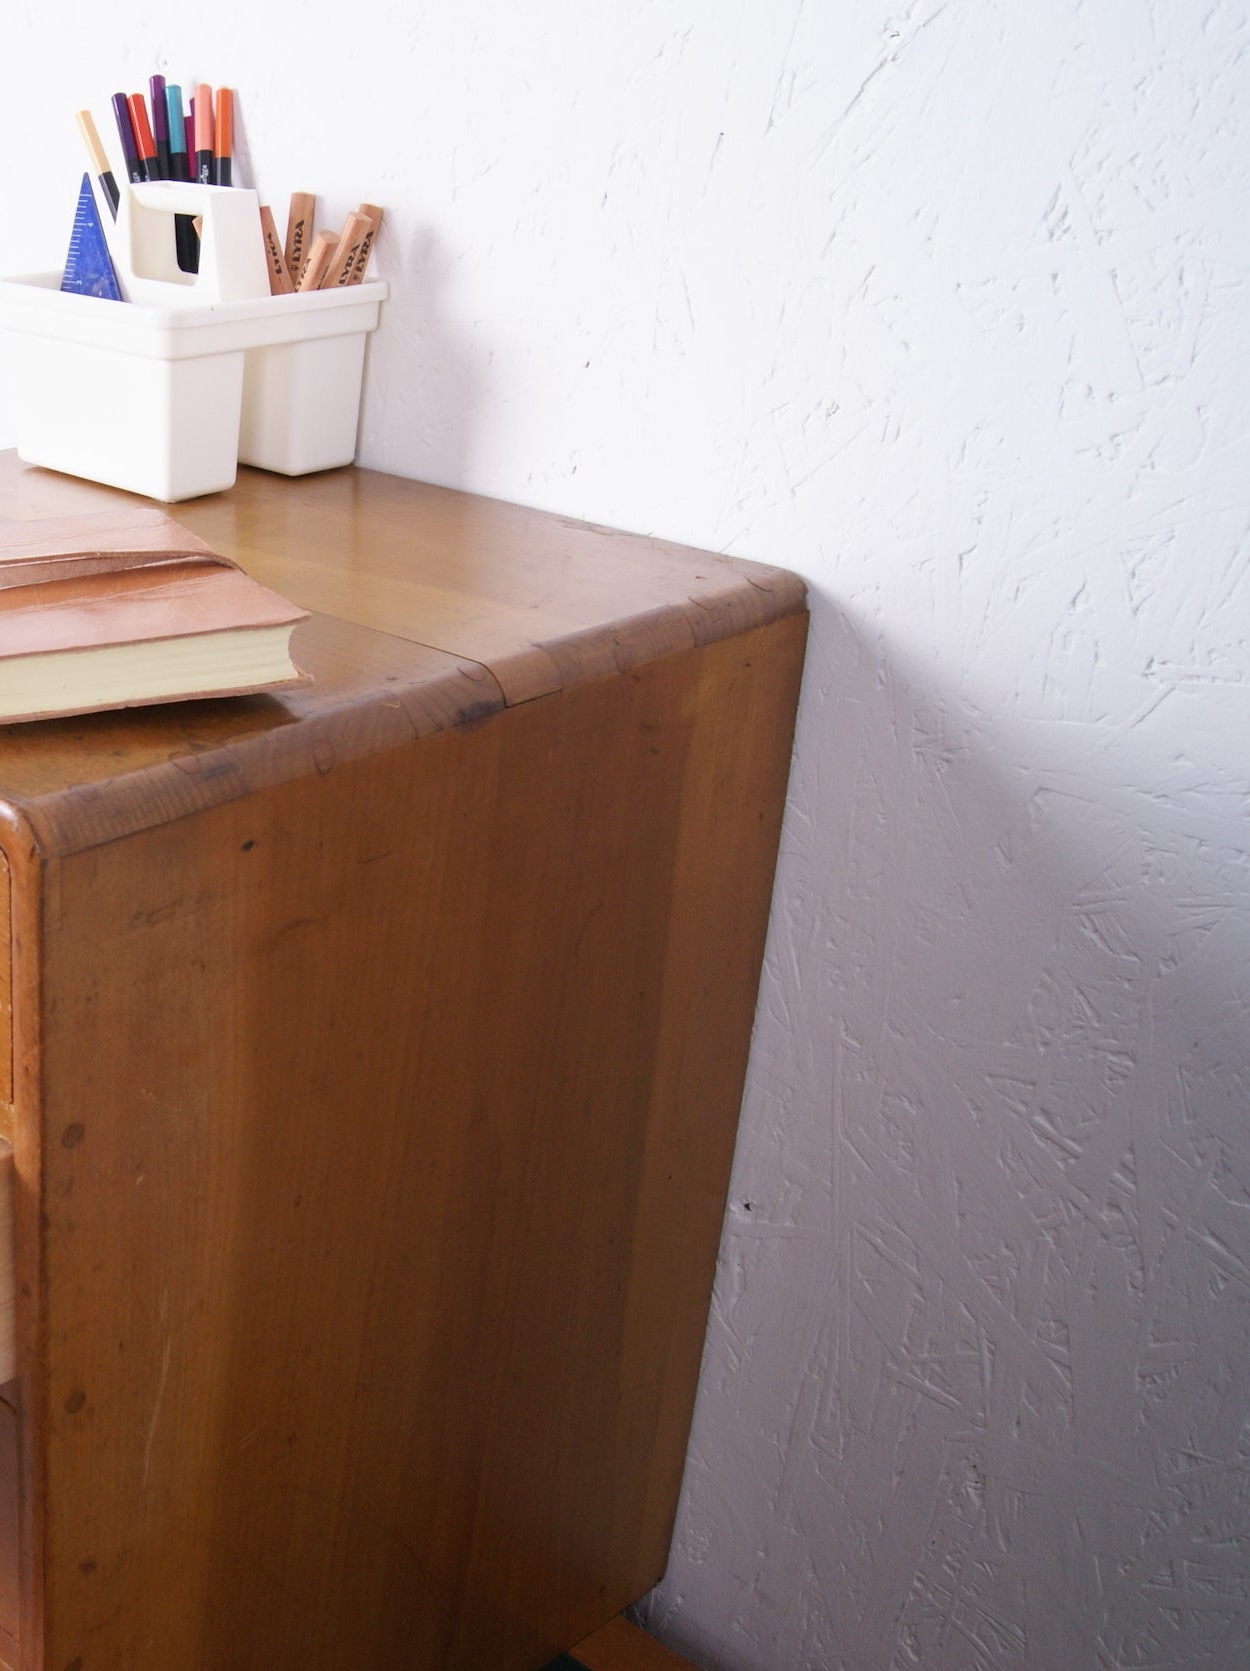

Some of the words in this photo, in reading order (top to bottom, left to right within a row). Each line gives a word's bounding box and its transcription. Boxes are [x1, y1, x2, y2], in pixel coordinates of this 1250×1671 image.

[292, 220, 305, 262] LYRA
[355, 231, 374, 273] LYRA
[339, 244, 360, 285] LYRA
